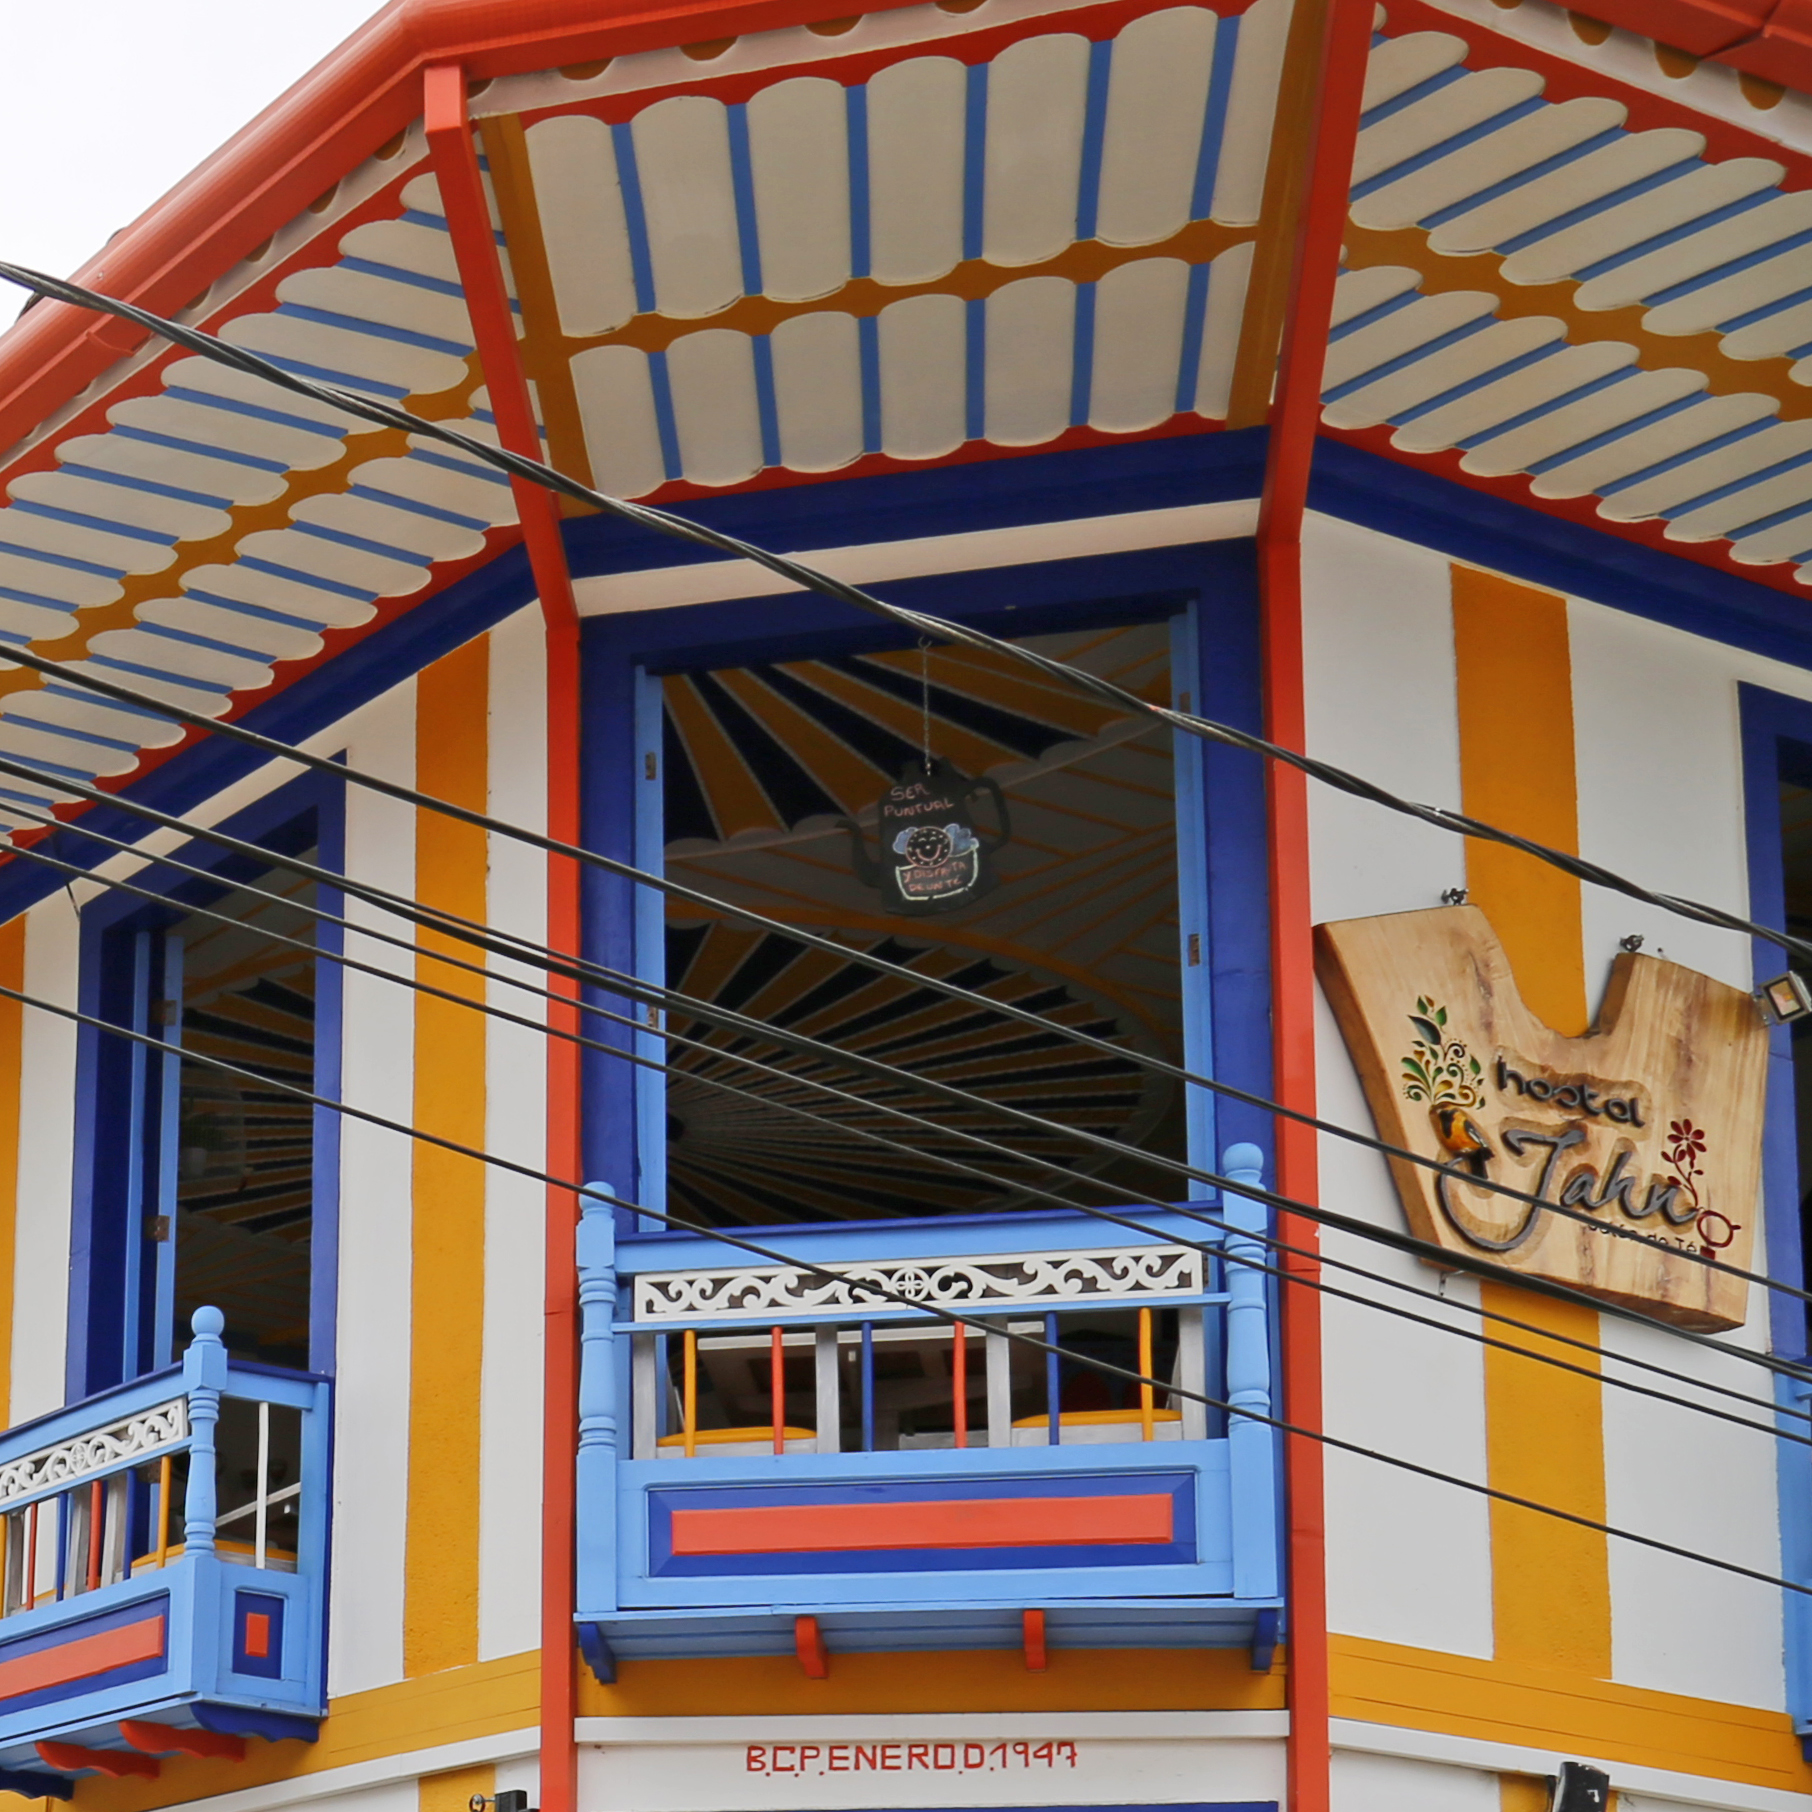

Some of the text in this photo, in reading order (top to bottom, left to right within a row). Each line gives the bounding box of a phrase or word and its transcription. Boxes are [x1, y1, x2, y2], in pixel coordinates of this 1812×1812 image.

[890, 782, 930, 802] SER
[883, 797, 955, 817] PUNTUAL
[1495, 1054, 1645, 1129] hostal
